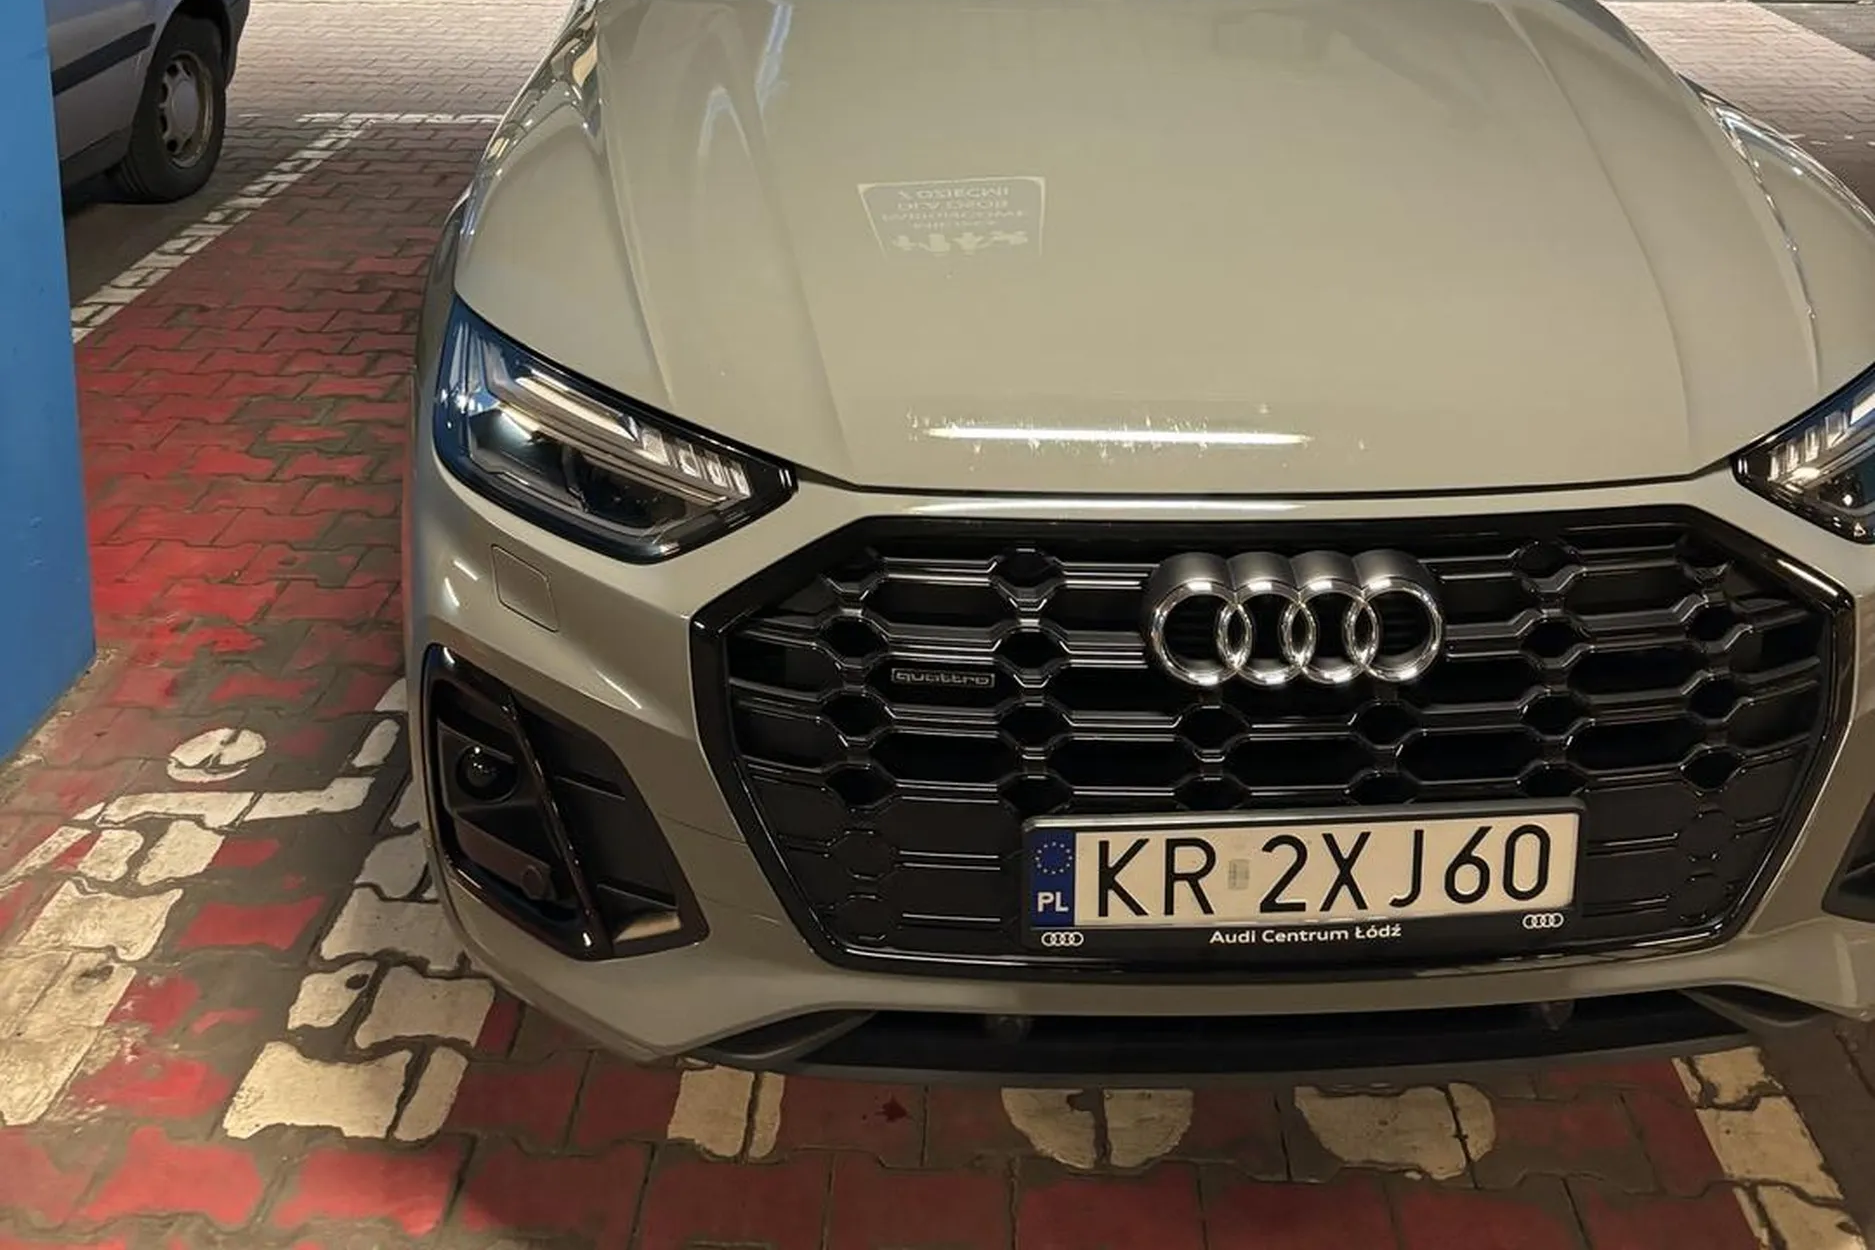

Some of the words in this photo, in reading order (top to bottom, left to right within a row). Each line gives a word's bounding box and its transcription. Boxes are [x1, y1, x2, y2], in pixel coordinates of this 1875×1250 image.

[895, 672, 990, 685] quattro
[1098, 837, 1217, 917] KR
[1259, 824, 1551, 913] 2XJ60
[1037, 891, 1069, 912] PL
[1209, 930, 1256, 944] Audi
[1261, 928, 1350, 943] Centrum
[1354, 923, 1402, 939] Łódź
